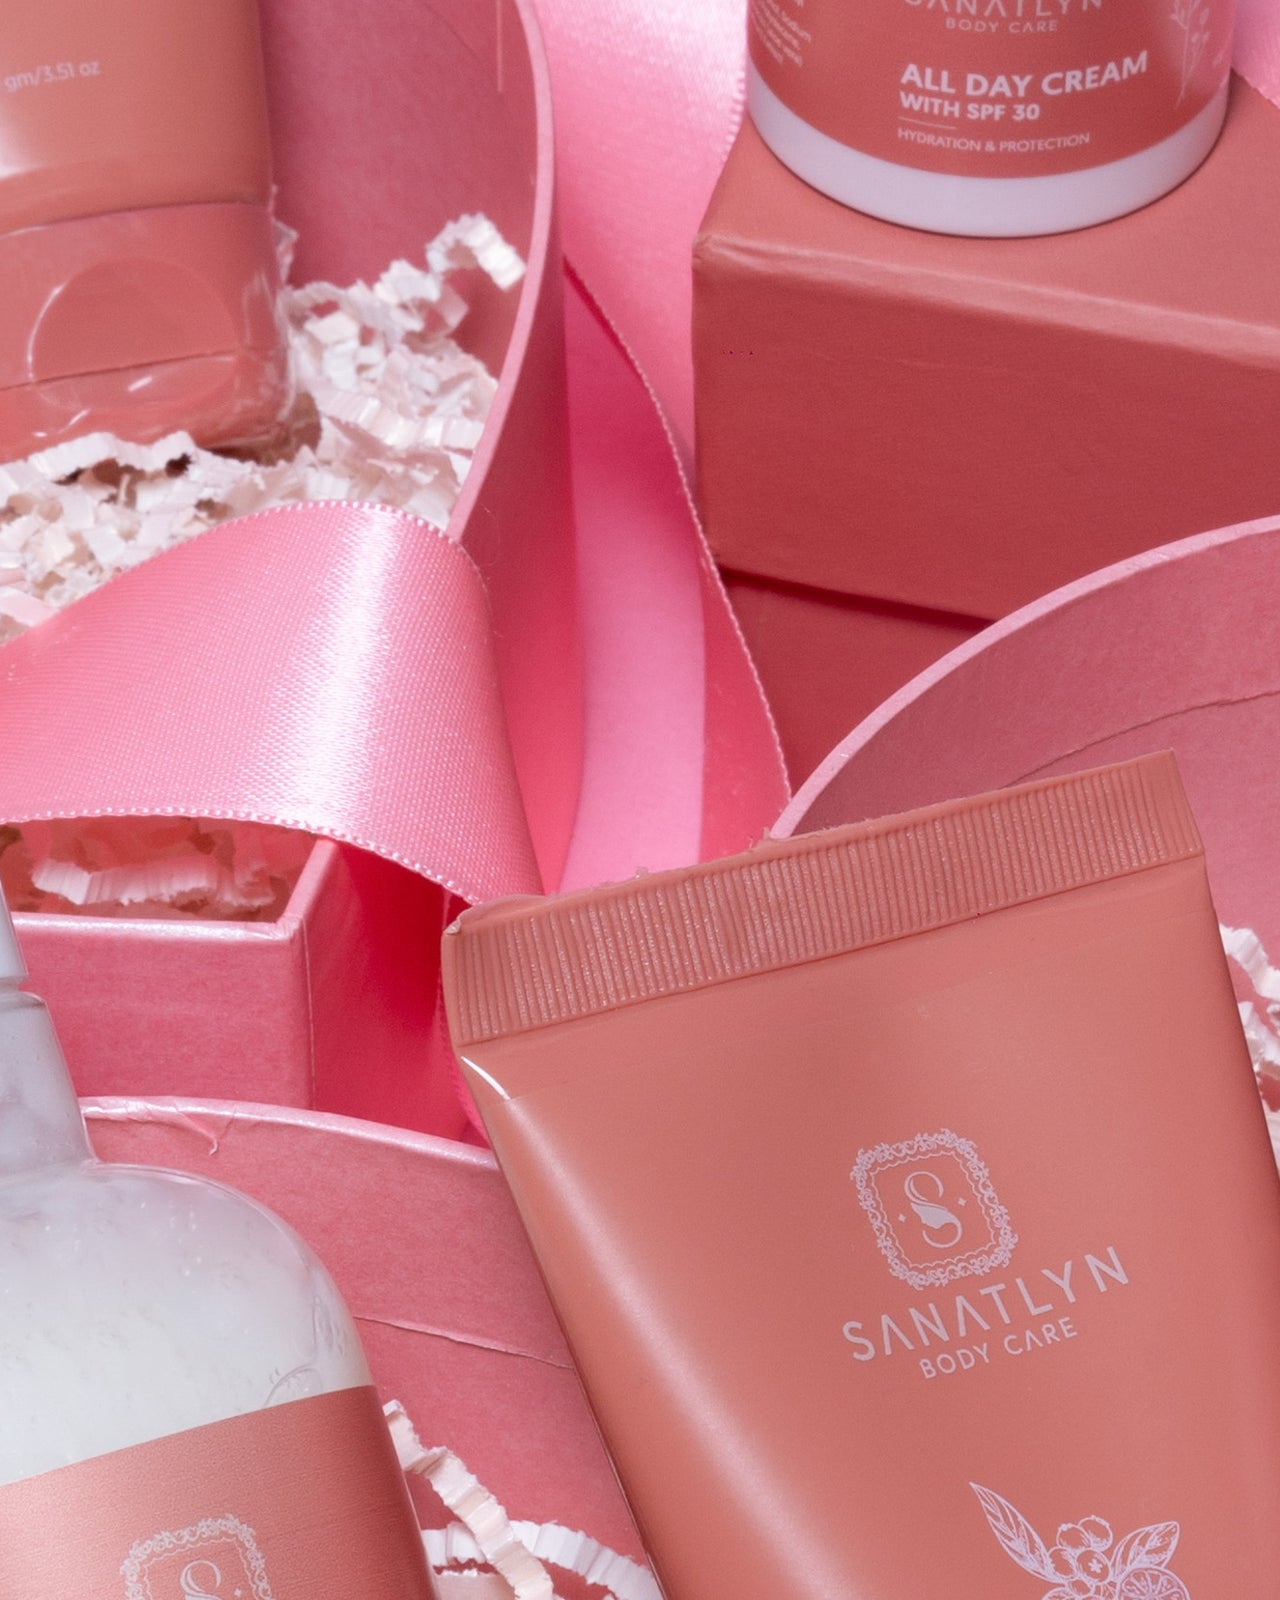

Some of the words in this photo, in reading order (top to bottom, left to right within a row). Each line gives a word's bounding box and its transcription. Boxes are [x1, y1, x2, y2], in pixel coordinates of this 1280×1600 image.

[945, 17, 999, 33] BODY
[1008, 20, 1058, 34] CARE
[79, 61, 101, 78] oz
[900, 63, 956, 94] ALL
[965, 73, 1033, 97] DAY
[1041, 50, 1148, 95] CREAM
[899, 91, 960, 118] WITH
[966, 103, 1007, 121] SPF
[1012, 103, 1041, 121] 30
[898, 128, 981, 152] HYDRATION
[984, 140, 996, 152] &
[999, 132, 1091, 153] PROTECTION
[842, 1246, 1129, 1361] SANATLYN
[919, 1342, 990, 1379] BODY
[1004, 1316, 1077, 1355] CARE
